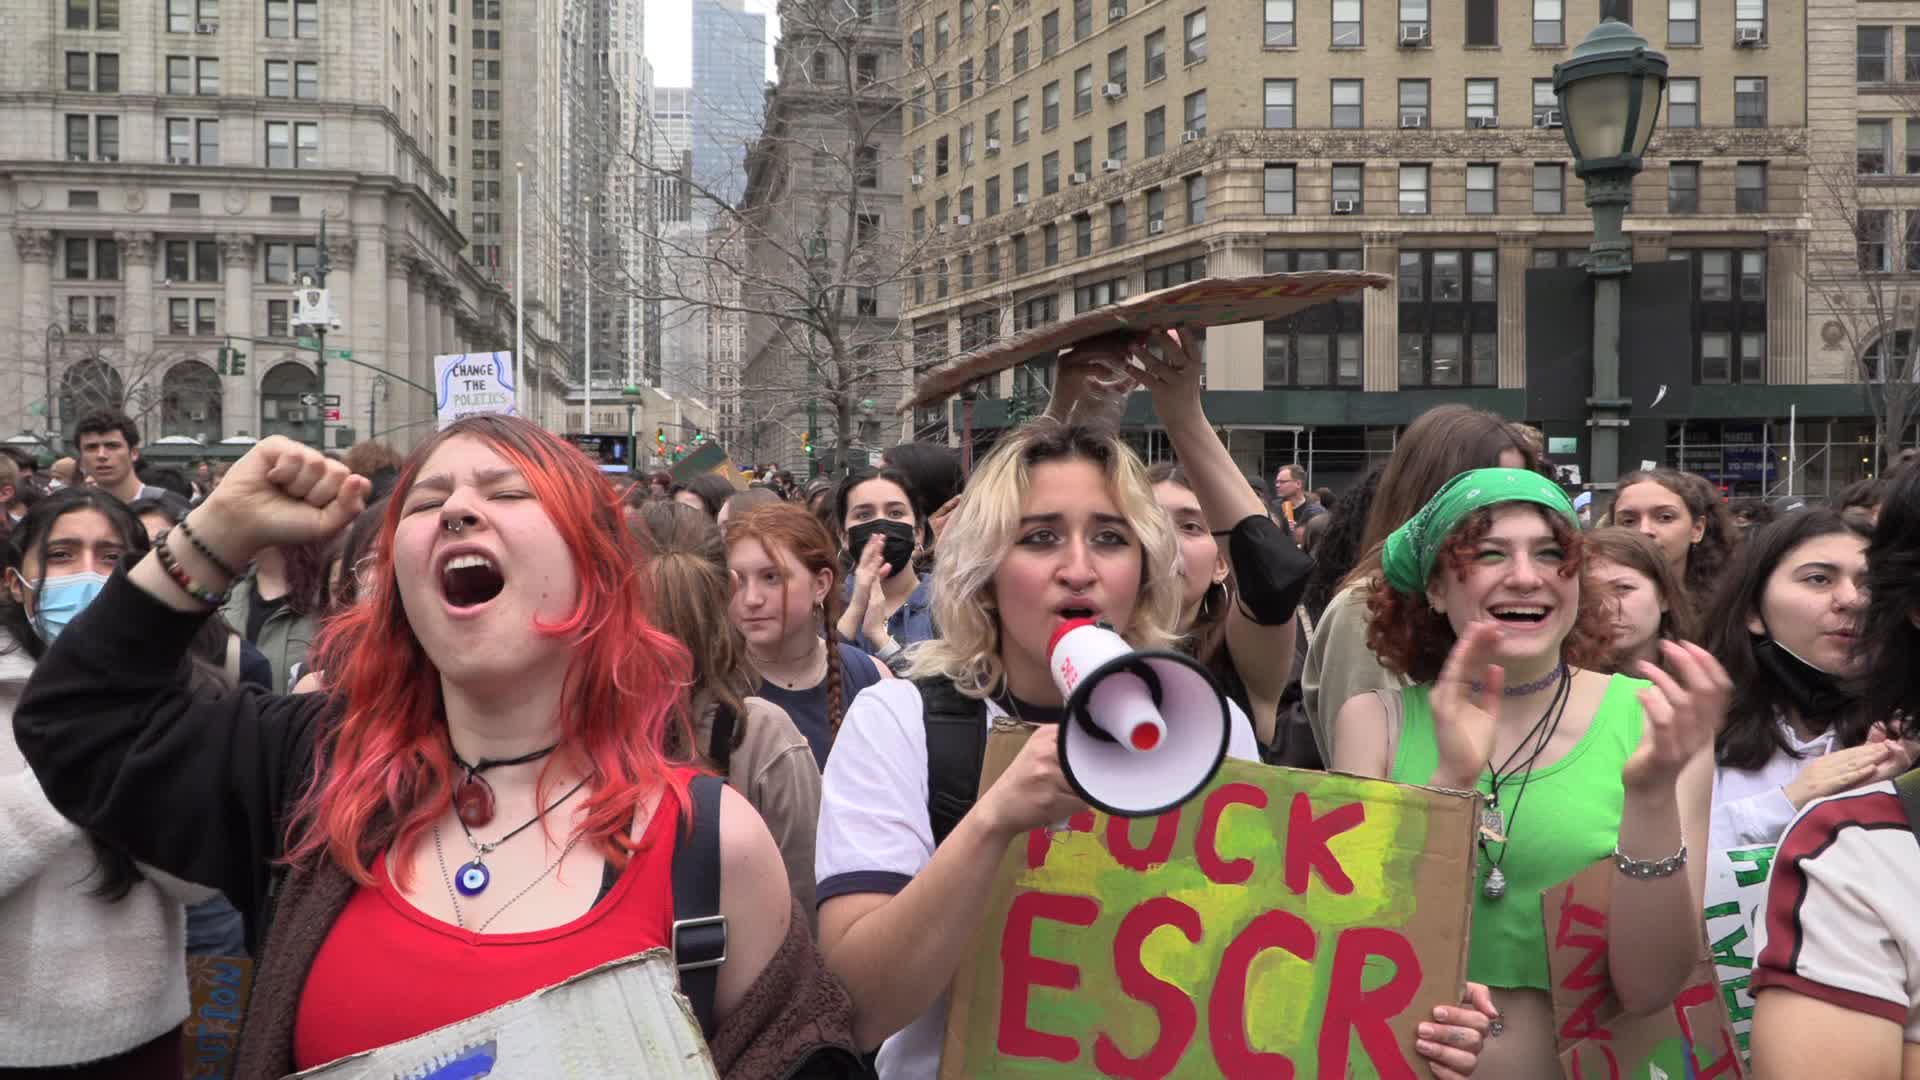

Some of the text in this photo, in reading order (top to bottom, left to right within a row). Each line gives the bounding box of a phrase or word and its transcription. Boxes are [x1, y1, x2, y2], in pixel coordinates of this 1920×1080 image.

[452, 363, 494, 377] CHANGE
[464, 379, 487, 392] THE
[454, 392, 506, 406] POLITICS
[997, 890, 1424, 1080] ESCR
